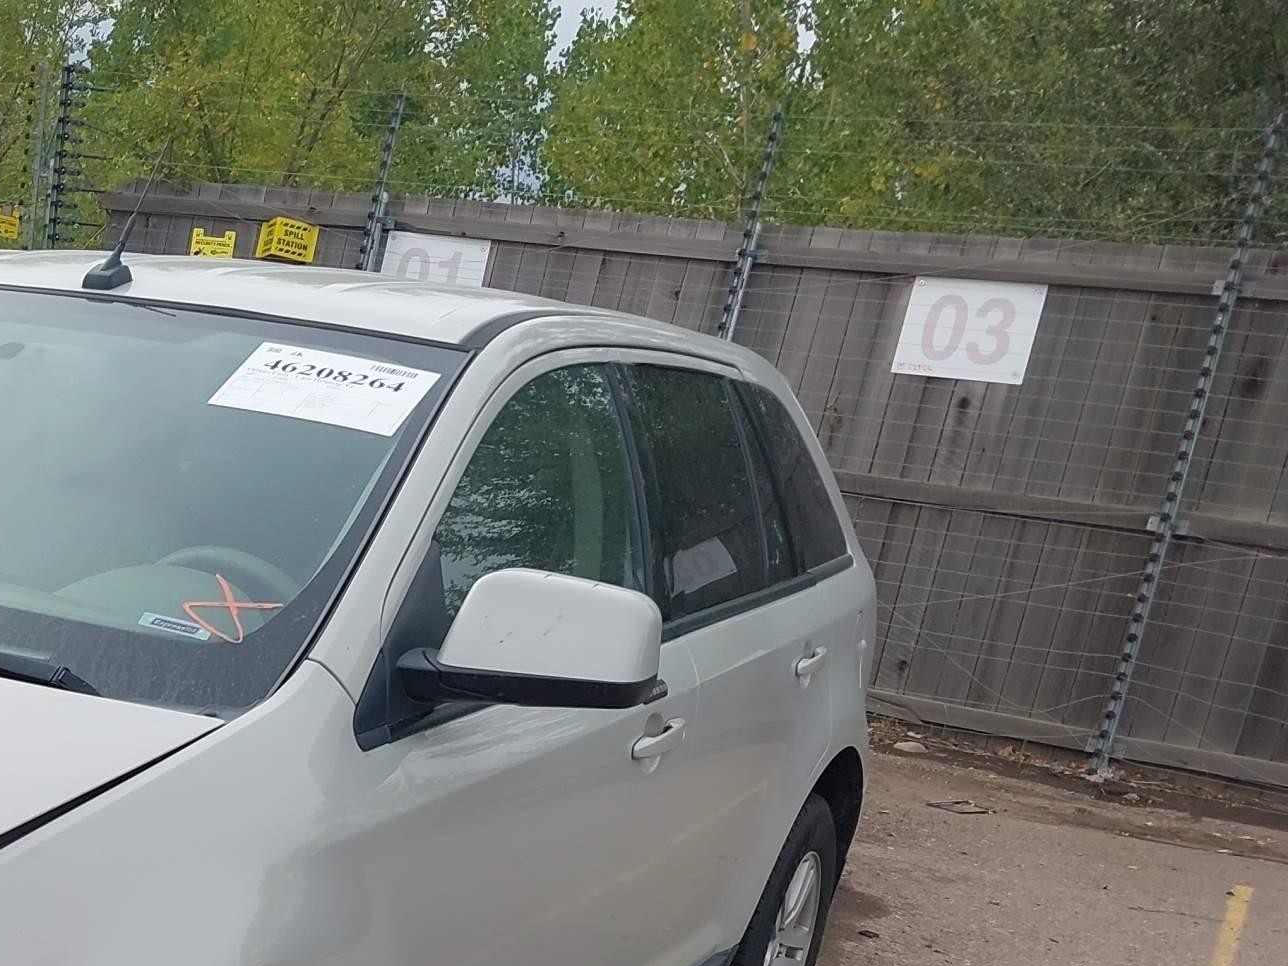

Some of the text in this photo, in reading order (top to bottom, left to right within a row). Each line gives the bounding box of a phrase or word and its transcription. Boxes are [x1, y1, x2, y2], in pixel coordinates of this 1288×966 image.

[277, 237, 309, 252] STATION
[283, 229, 305, 241] SPILL
[397, 247, 463, 285] 01
[921, 294, 1017, 366] 03
[263, 359, 405, 394] 46208264
